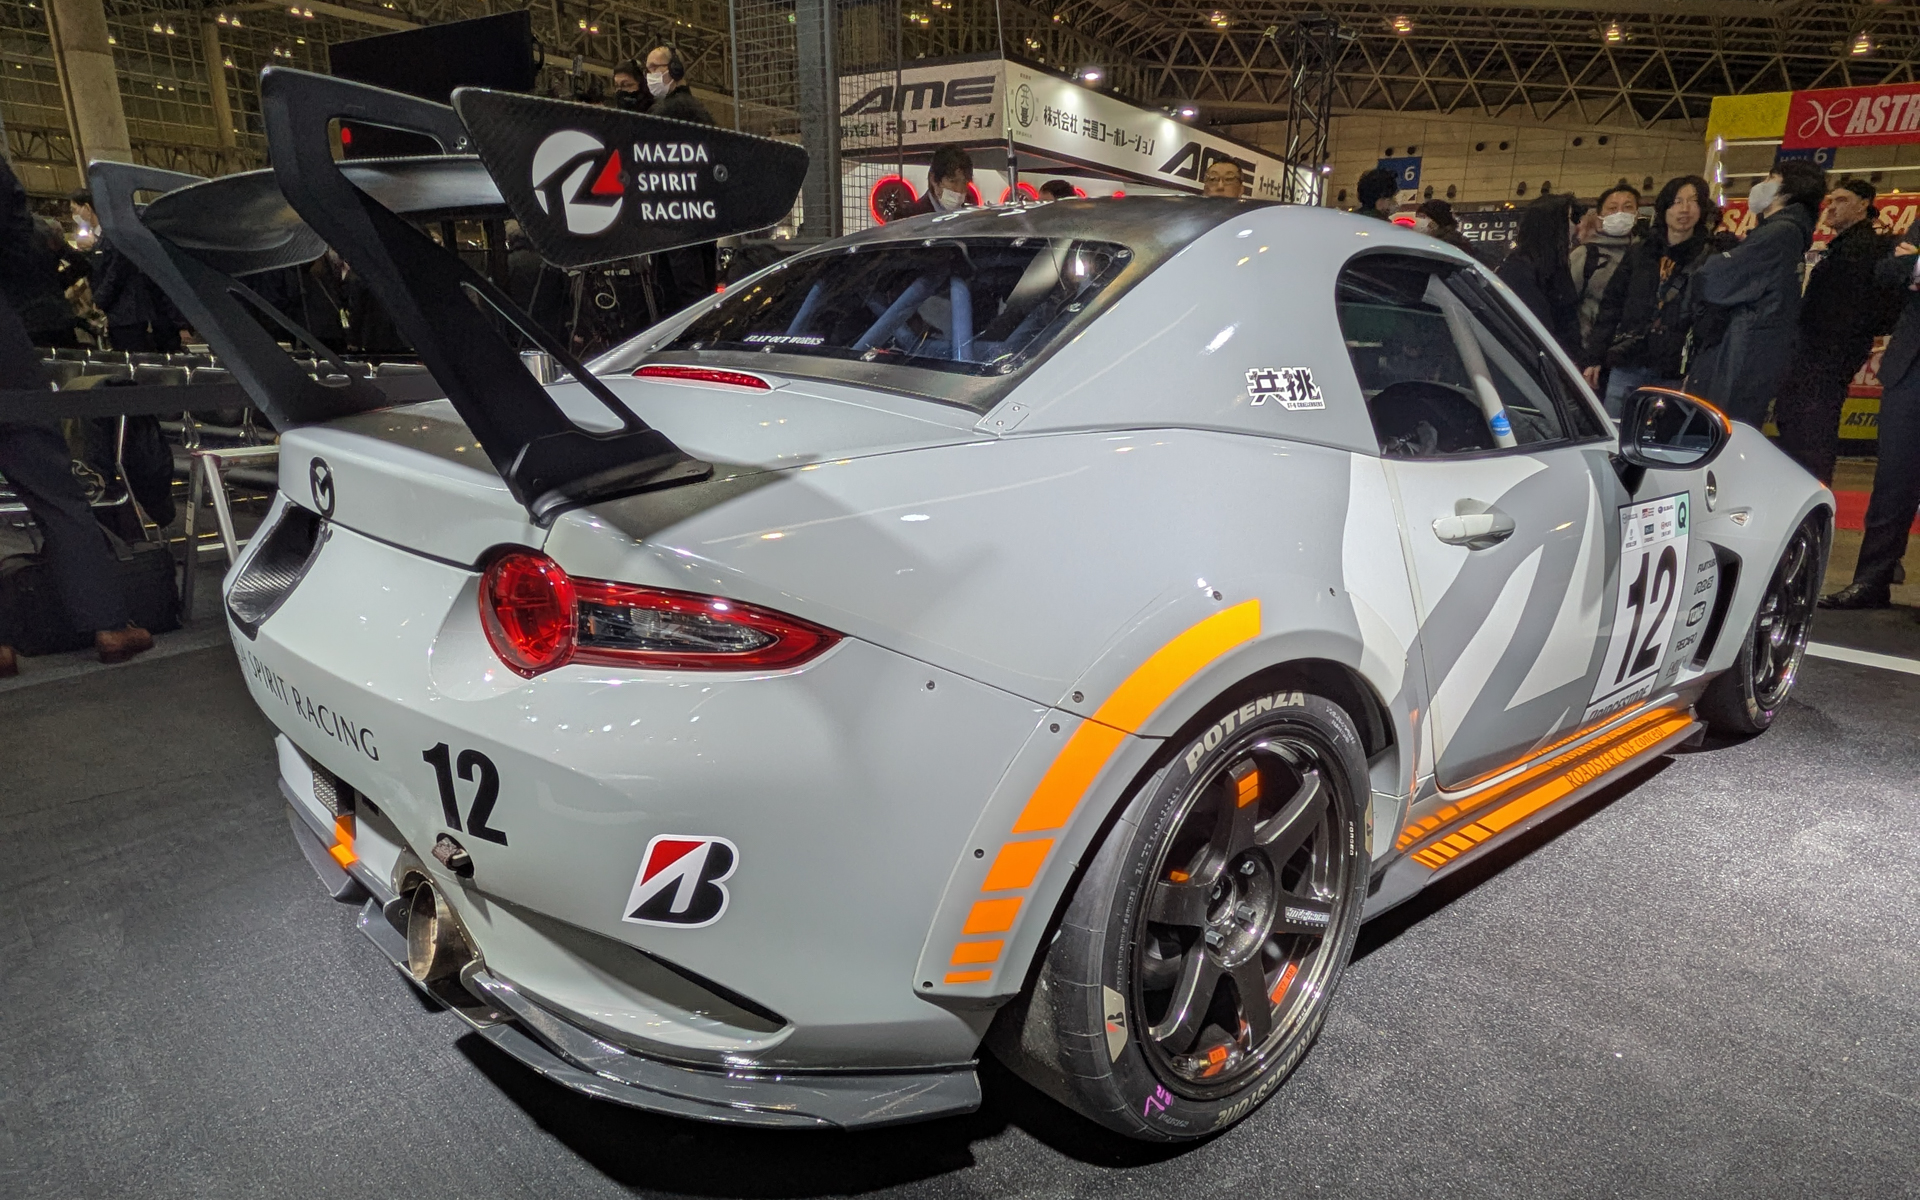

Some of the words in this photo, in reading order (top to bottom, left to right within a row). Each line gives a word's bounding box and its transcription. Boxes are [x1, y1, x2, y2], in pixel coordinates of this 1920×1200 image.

[841, 76, 996, 115] AME
[885, 113, 996, 134] 共コーポレーション
[1043, 105, 1078, 134] 株式会社
[633, 143, 709, 162] MAZDA
[1813, 147, 1828, 164] 6
[638, 173, 698, 192] SPIRIT
[1404, 166, 1415, 181] 6
[641, 201, 716, 221] RACING
[1678, 501, 1687, 529] Q
[1613, 545, 1678, 686] 12
[247, 651, 289, 706] SPIRIT
[291, 686, 380, 762] RACING
[1185, 692, 1305, 775] POTENZA
[1566, 749, 1618, 789] ROADSTER
[1634, 726, 1667, 750] concept
[422, 742, 508, 847] 12
